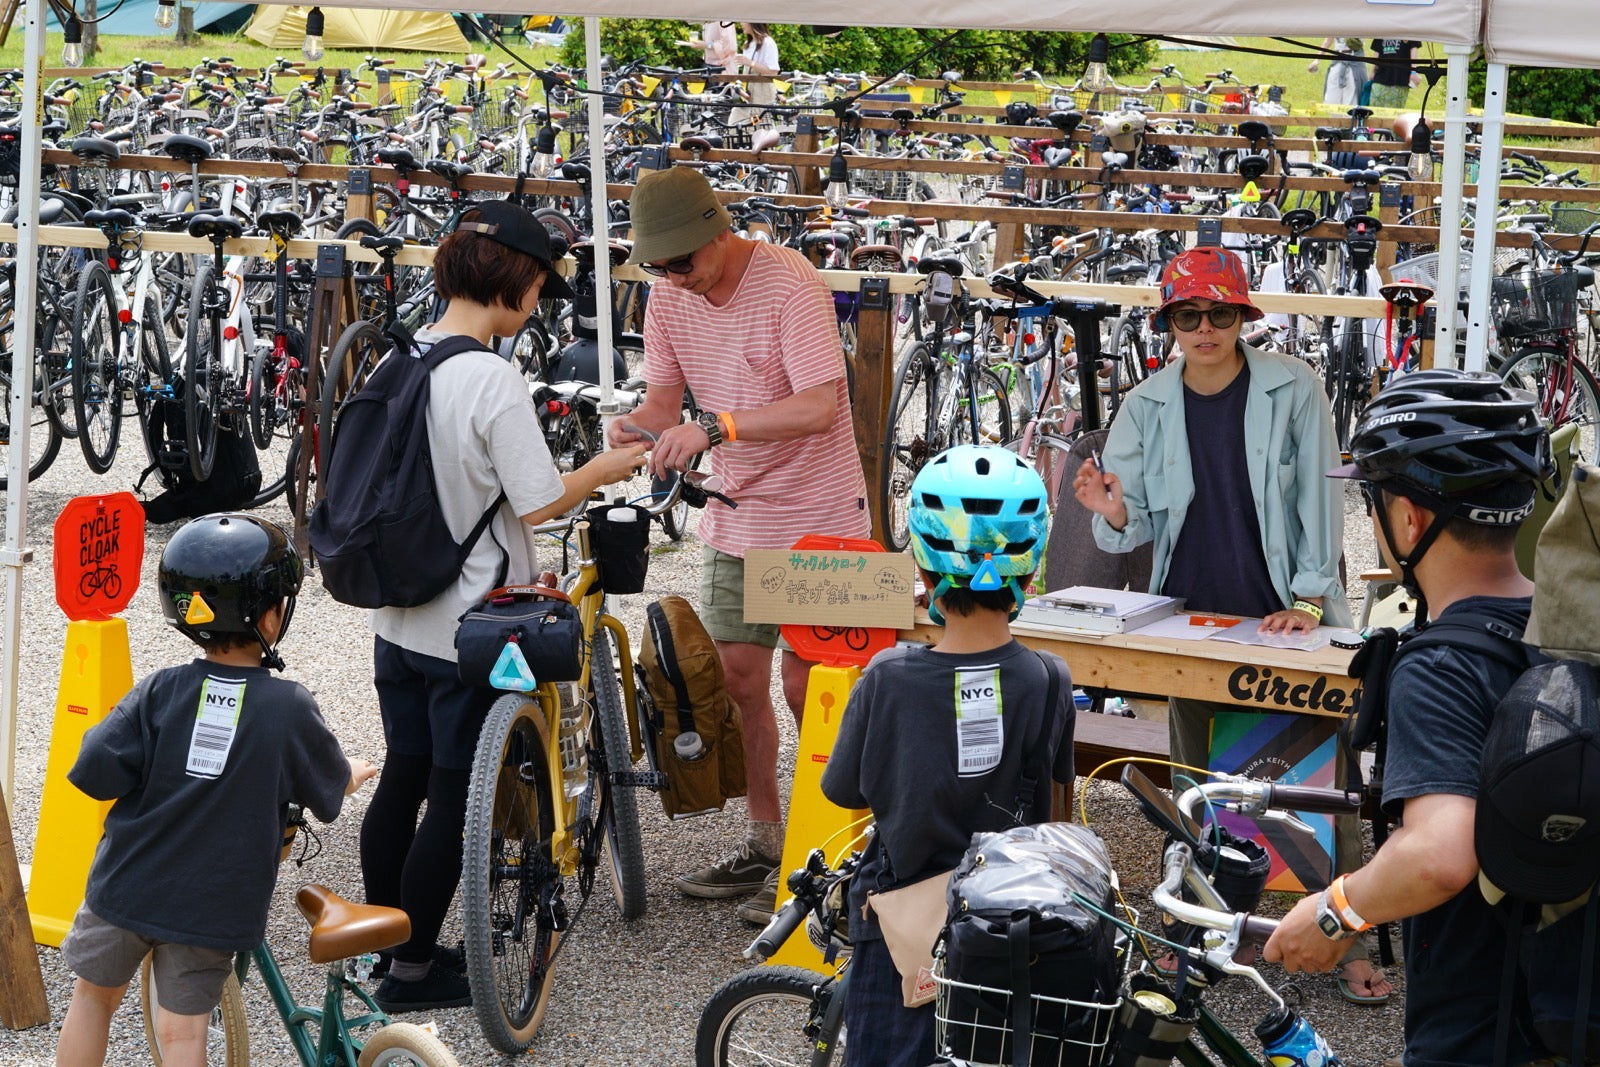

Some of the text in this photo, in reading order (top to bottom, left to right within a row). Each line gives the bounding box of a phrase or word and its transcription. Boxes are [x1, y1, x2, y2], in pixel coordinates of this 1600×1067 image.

[1380, 412, 1417, 425] GIRO
[96, 506, 106, 516] THE
[1469, 499, 1535, 524] GIRO
[80, 509, 121, 544] CYCLE
[80, 531, 120, 567] CLOAK
[206, 693, 237, 708] NYC
[960, 687, 994, 701] NYC
[1266, 757, 1291, 770] KEITH
[919, 981, 937, 991] KEL
